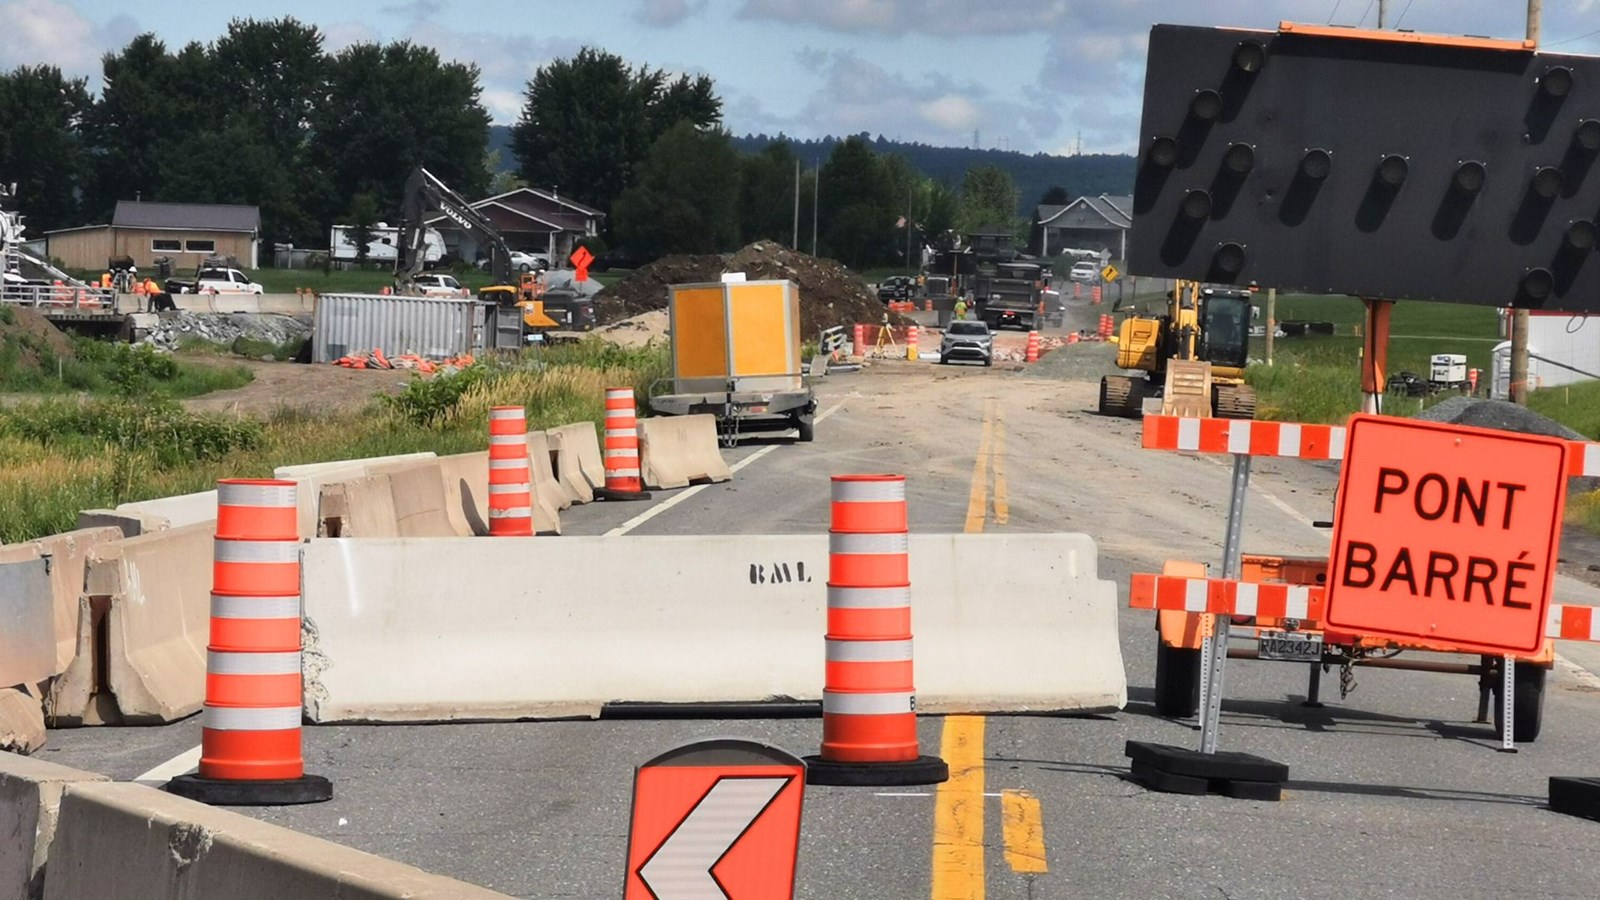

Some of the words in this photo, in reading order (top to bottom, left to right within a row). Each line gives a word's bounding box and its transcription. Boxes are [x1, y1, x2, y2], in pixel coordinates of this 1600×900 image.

[440, 200, 472, 229] VOLVO
[1374, 467, 1526, 530] PONT
[1342, 540, 1536, 610] BARRÉ
